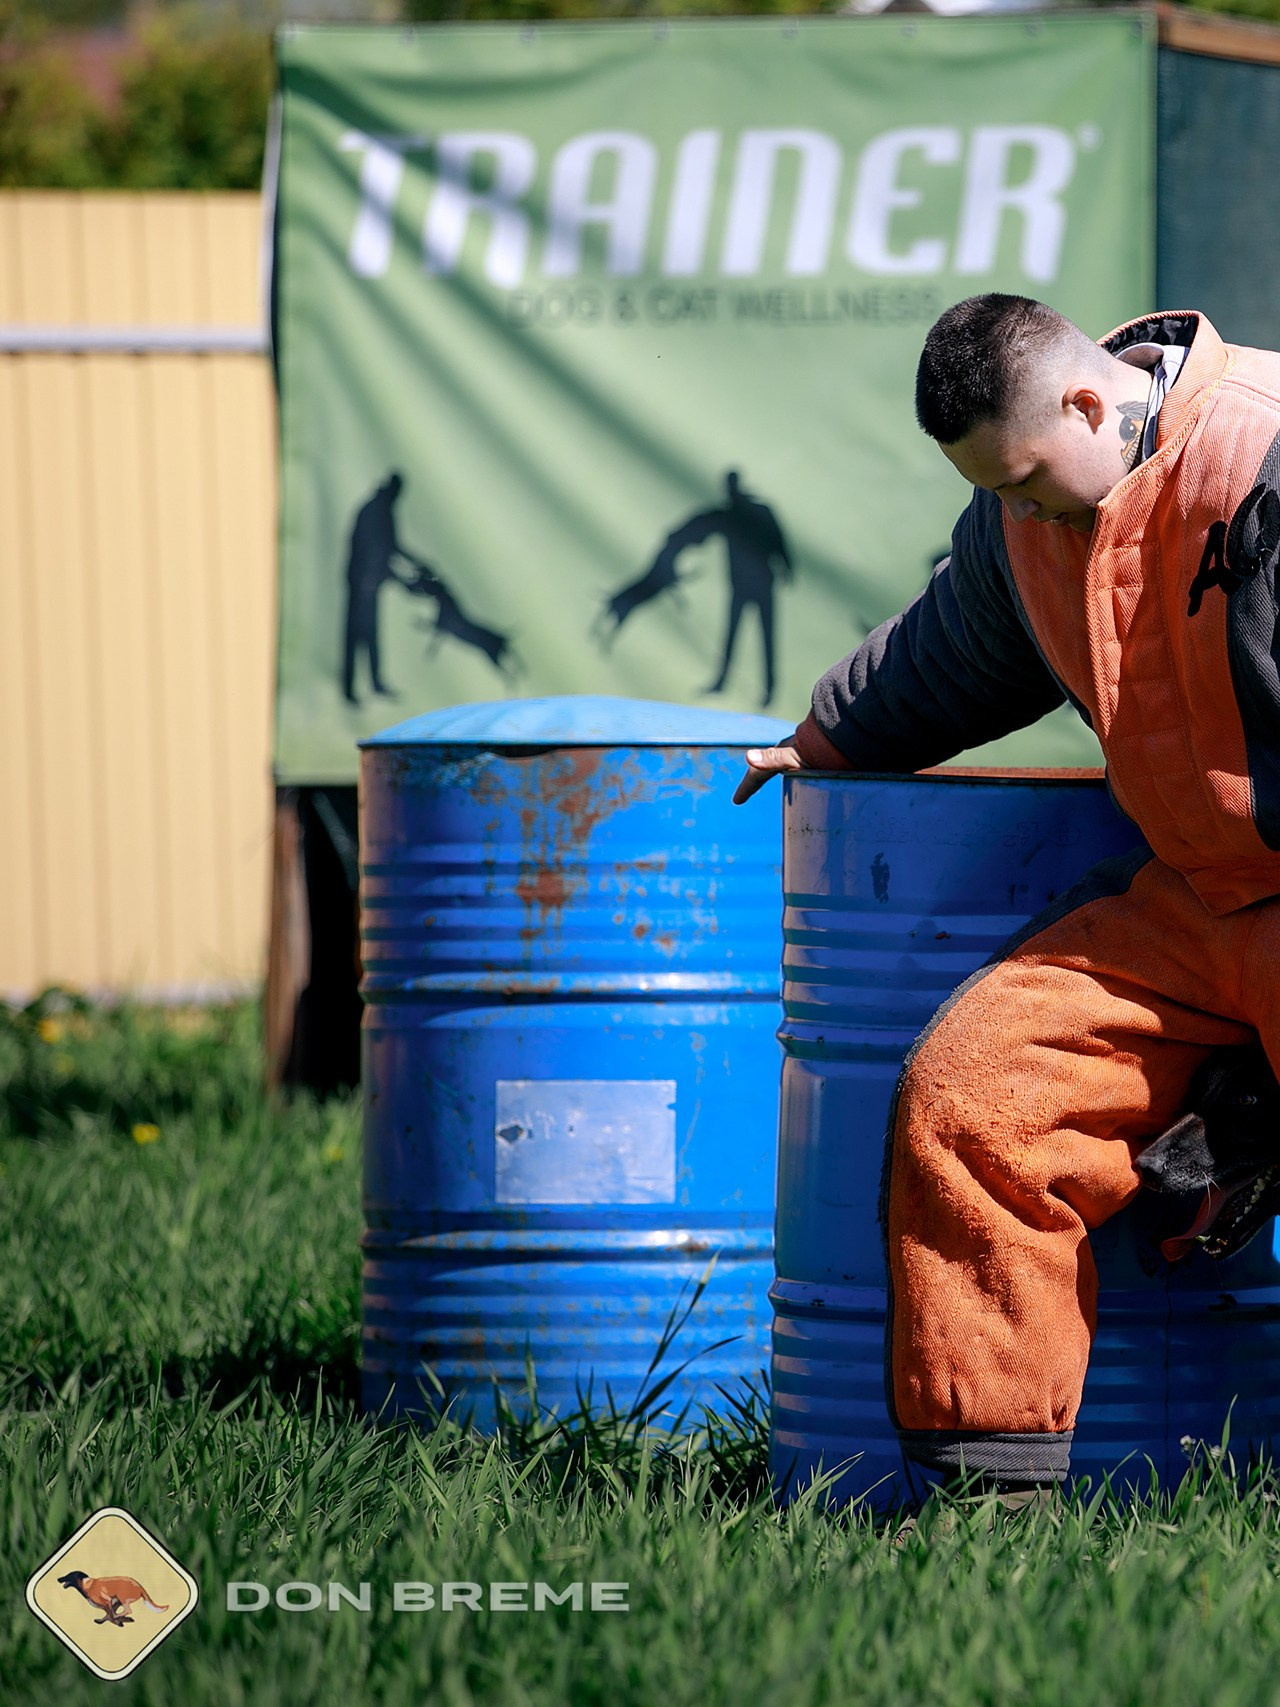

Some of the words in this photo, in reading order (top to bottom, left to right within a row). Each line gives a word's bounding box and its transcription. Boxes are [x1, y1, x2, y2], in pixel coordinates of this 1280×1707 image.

[339, 123, 1079, 287] TRAINER
[511, 285, 605, 326] DOG
[613, 286, 639, 324] &
[648, 287, 726, 325] CAT
[733, 287, 942, 325] WELLNESS
